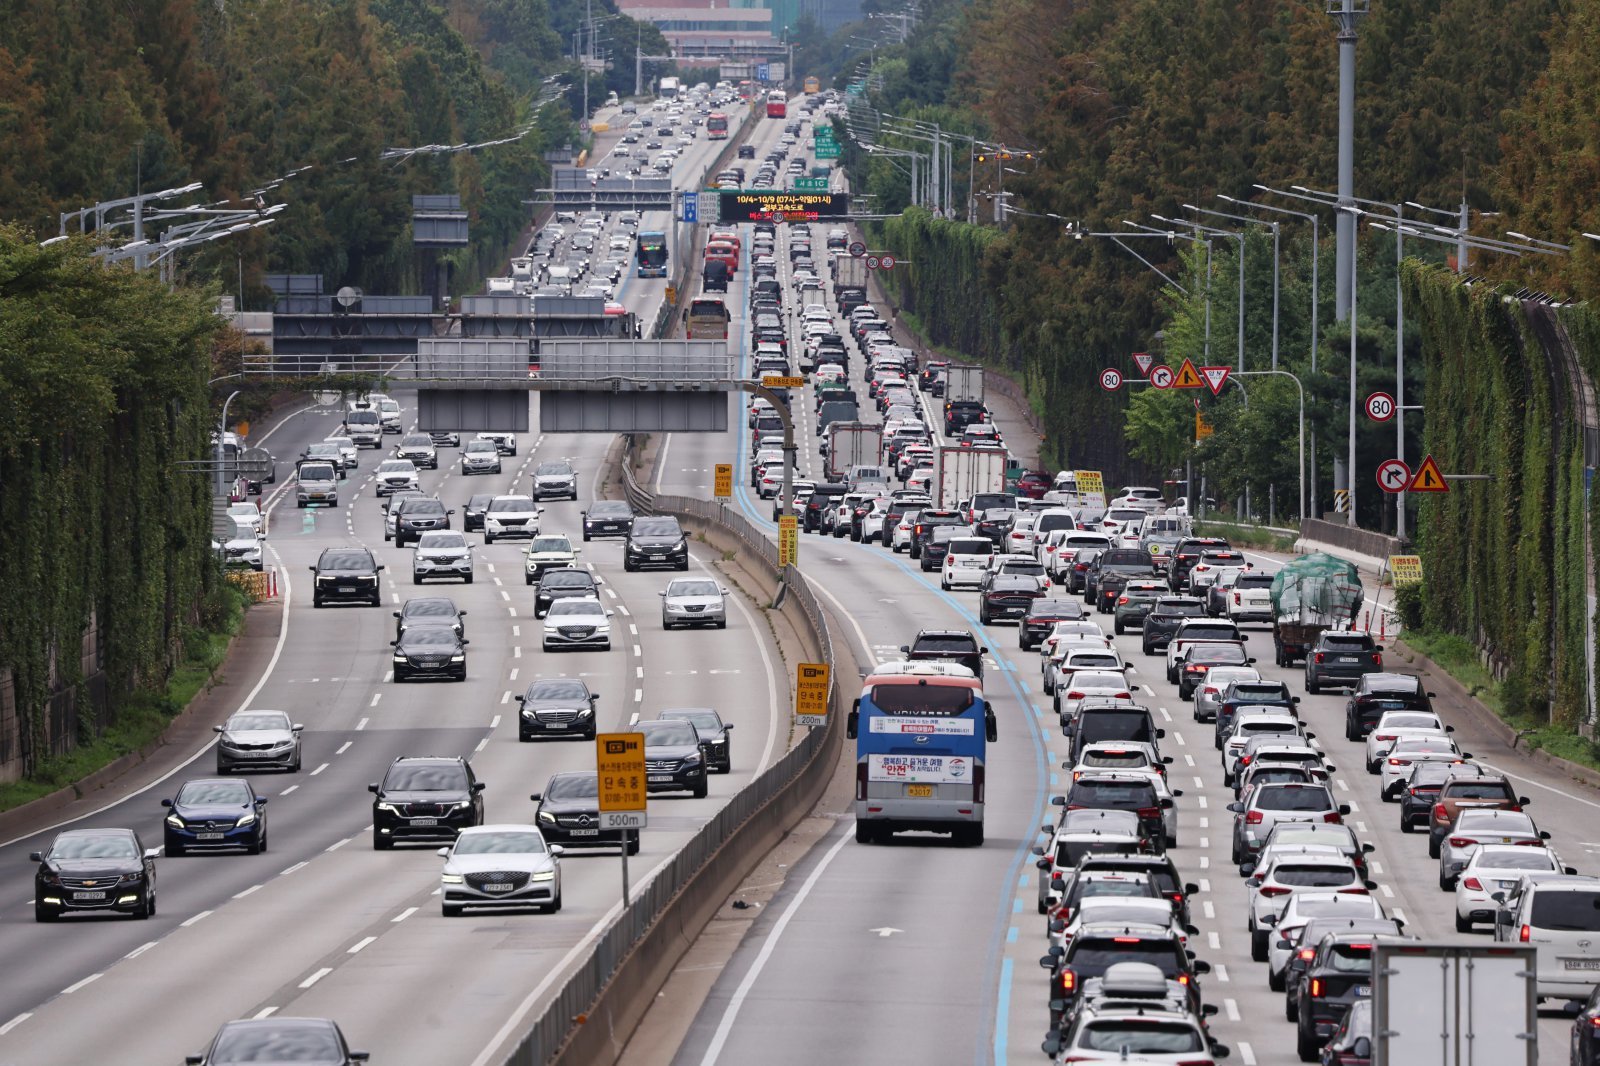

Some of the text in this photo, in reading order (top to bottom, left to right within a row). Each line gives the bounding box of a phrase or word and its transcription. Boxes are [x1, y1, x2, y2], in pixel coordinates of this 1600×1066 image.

[1104, 375, 1118, 386] 80
[1372, 401, 1390, 415] 80
[802, 716, 821, 725] 200m
[883, 757, 908, 765] 행복하고
[929, 758, 943, 766] 여행
[608, 814, 639, 826] 500m
